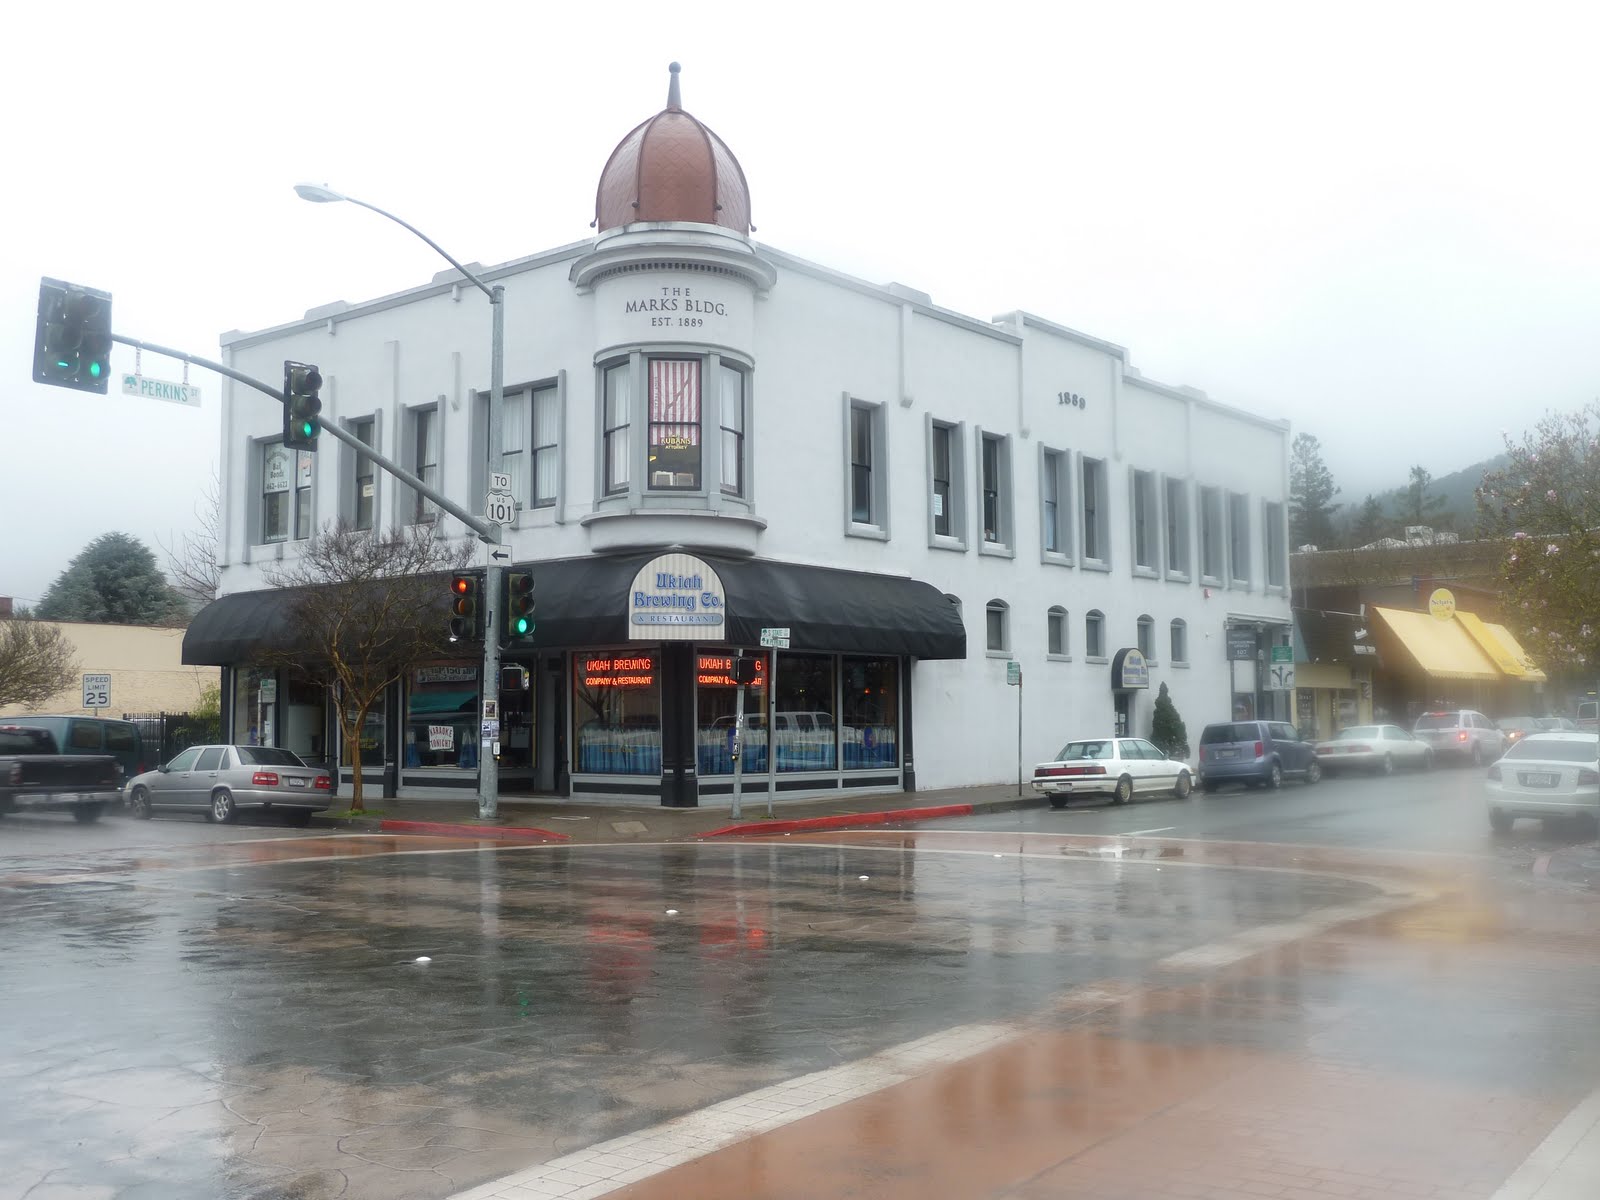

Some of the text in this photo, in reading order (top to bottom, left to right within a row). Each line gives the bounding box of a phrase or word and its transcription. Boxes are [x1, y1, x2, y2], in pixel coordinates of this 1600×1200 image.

[662, 287, 690, 297] THE
[625, 298, 728, 316] MARKS BLDG.
[651, 317, 703, 327] EST. 1889
[141, 379, 188, 402] PERKINS
[494, 476, 508, 486] TO
[490, 503, 511, 521] 101
[656, 572, 703, 590] Ukiah
[634, 591, 723, 611] Brewing Co.
[586, 658, 651, 671] UKIAH BREWING
[699, 658, 723, 669] UKIAH
[585, 677, 612, 685] COMPANY
[618, 676, 652, 685] RESTAURANT
[698, 675, 724, 684] COMPANY
[86, 692, 108, 704] 25
[430, 726, 453, 738] KARAOKE
[430, 739, 451, 748] TONIGHT
